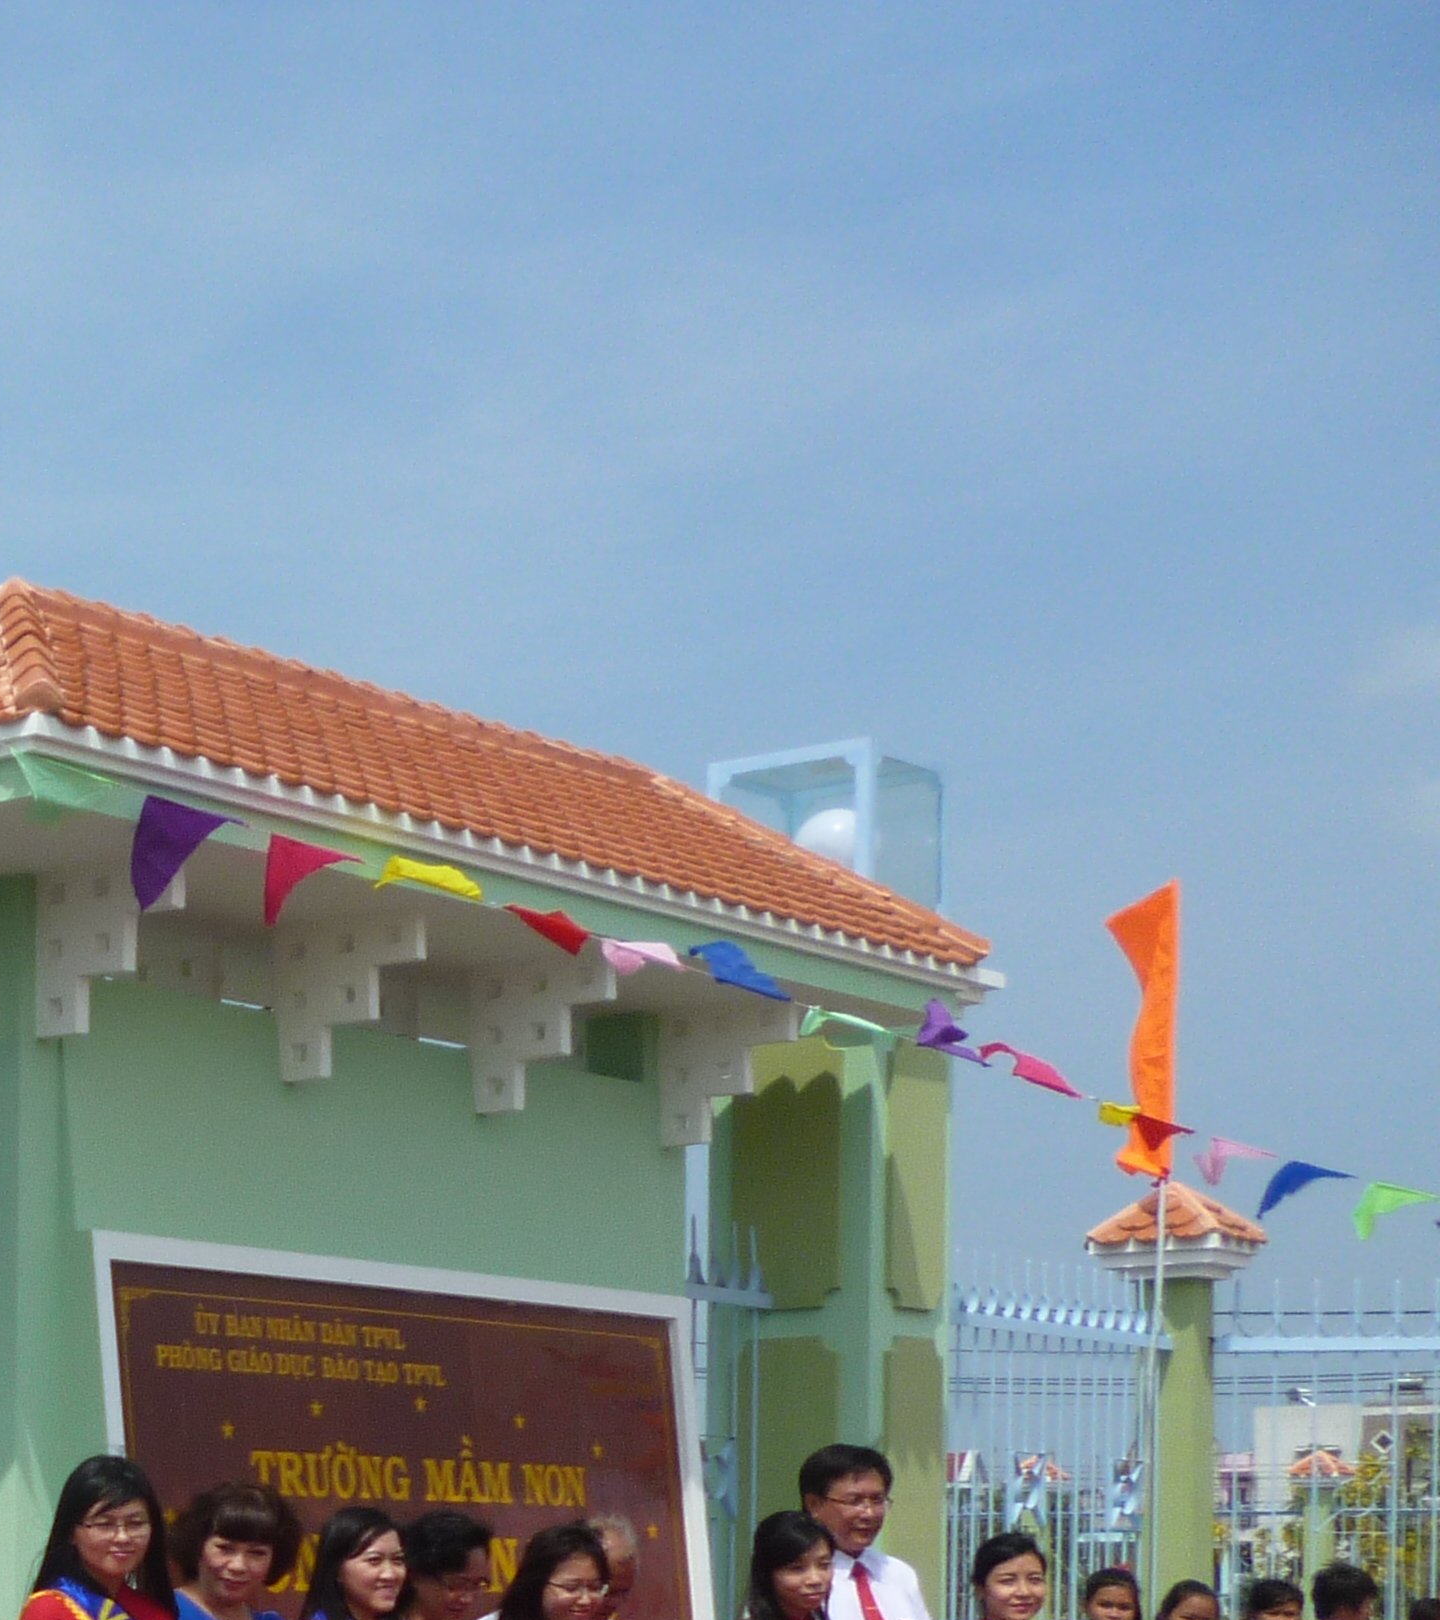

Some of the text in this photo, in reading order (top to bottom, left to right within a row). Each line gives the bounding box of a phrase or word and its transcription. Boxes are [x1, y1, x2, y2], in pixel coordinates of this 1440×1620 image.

[224, 1314, 263, 1338] BAN
[250, 1434, 587, 1507] TRƯỜNG MẦM NON
